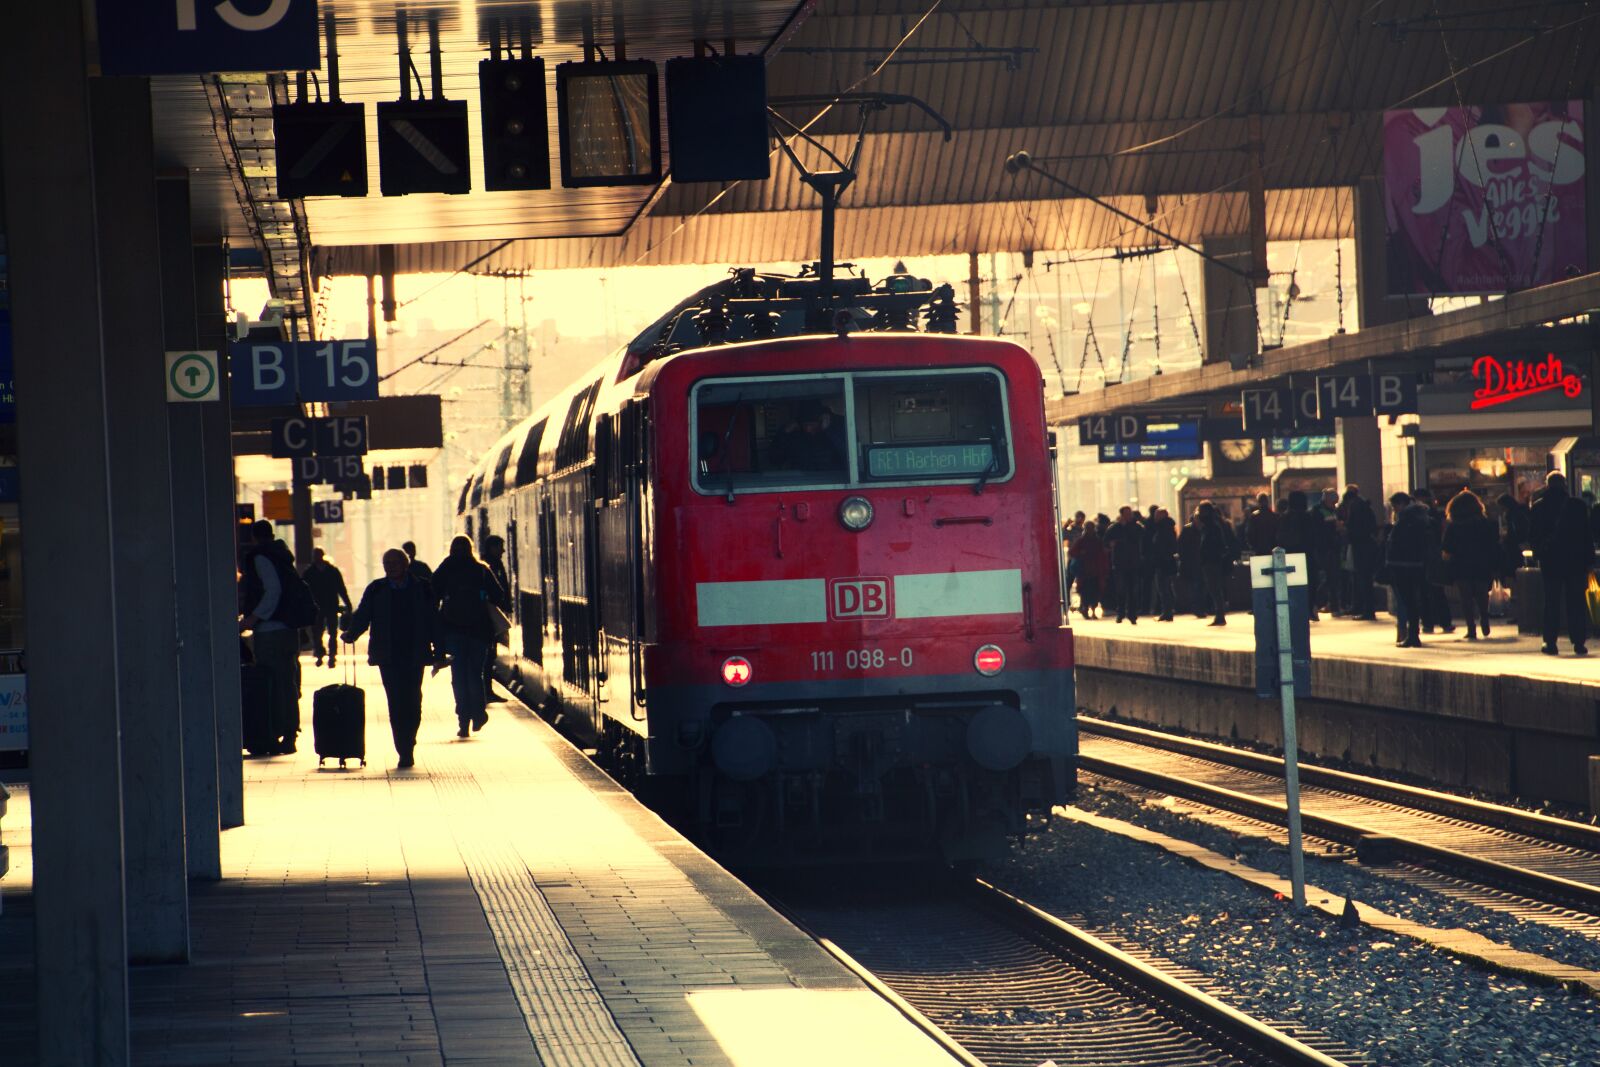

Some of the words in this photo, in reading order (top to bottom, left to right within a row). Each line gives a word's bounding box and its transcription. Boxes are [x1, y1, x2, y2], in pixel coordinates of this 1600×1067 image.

[1486, 175, 1539, 207] Alles
[251, 345, 287, 391] B
[315, 341, 370, 388] 15
[1471, 352, 1563, 399] Ditsch
[1250, 391, 1282, 420] 14
[1323, 376, 1360, 409] 14
[1380, 375, 1403, 406] B
[282, 418, 307, 450] C
[326, 418, 362, 448] 15
[1082, 416, 1108, 440] 14
[1120, 415, 1139, 438] D
[301, 457, 319, 480] D
[333, 456, 361, 478] 15
[906, 448, 957, 469] Aachen
[962, 447, 988, 466] Hbf
[320, 501, 342, 519] 15
[838, 583, 884, 614] DB
[810, 651, 834, 671] 111
[846, 647, 913, 670] 098-0
